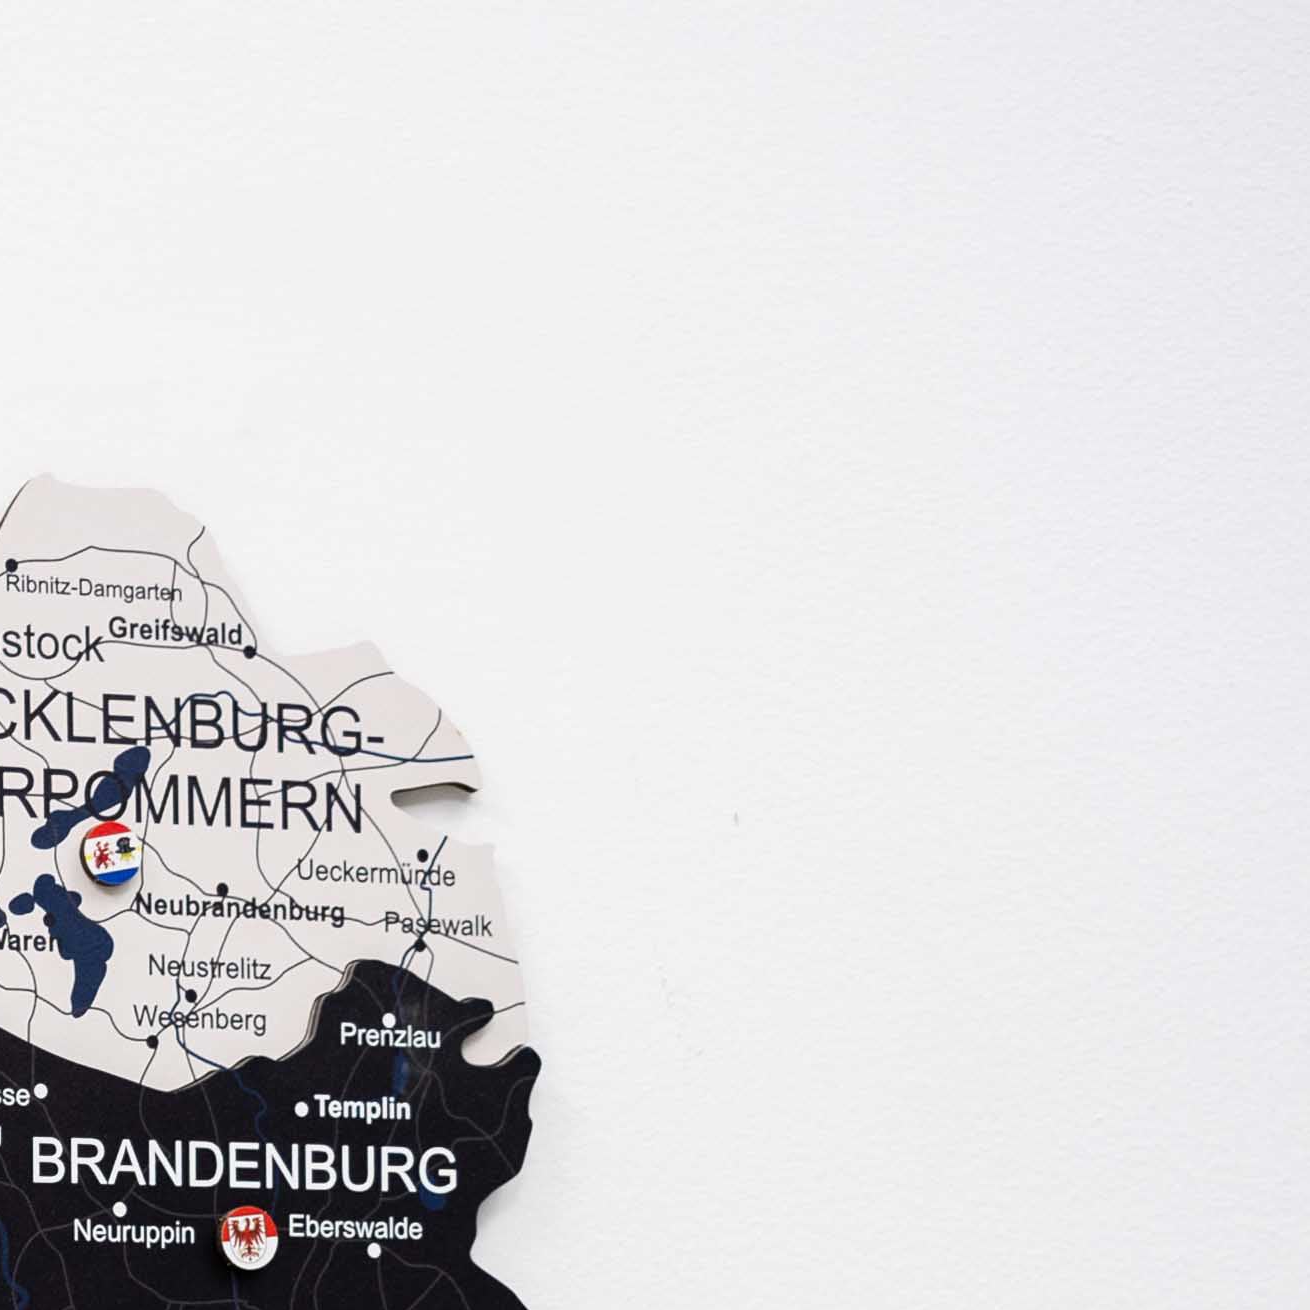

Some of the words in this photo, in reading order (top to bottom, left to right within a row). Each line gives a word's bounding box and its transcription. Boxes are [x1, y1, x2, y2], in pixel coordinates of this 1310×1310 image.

[6, 573, 182, 602] Ribnitz-Damgarten
[315, 1095, 410, 1123] Templin
[33, 1137, 456, 1193] BRANDENBURG
[74, 1219, 194, 1248] Neuruppin
